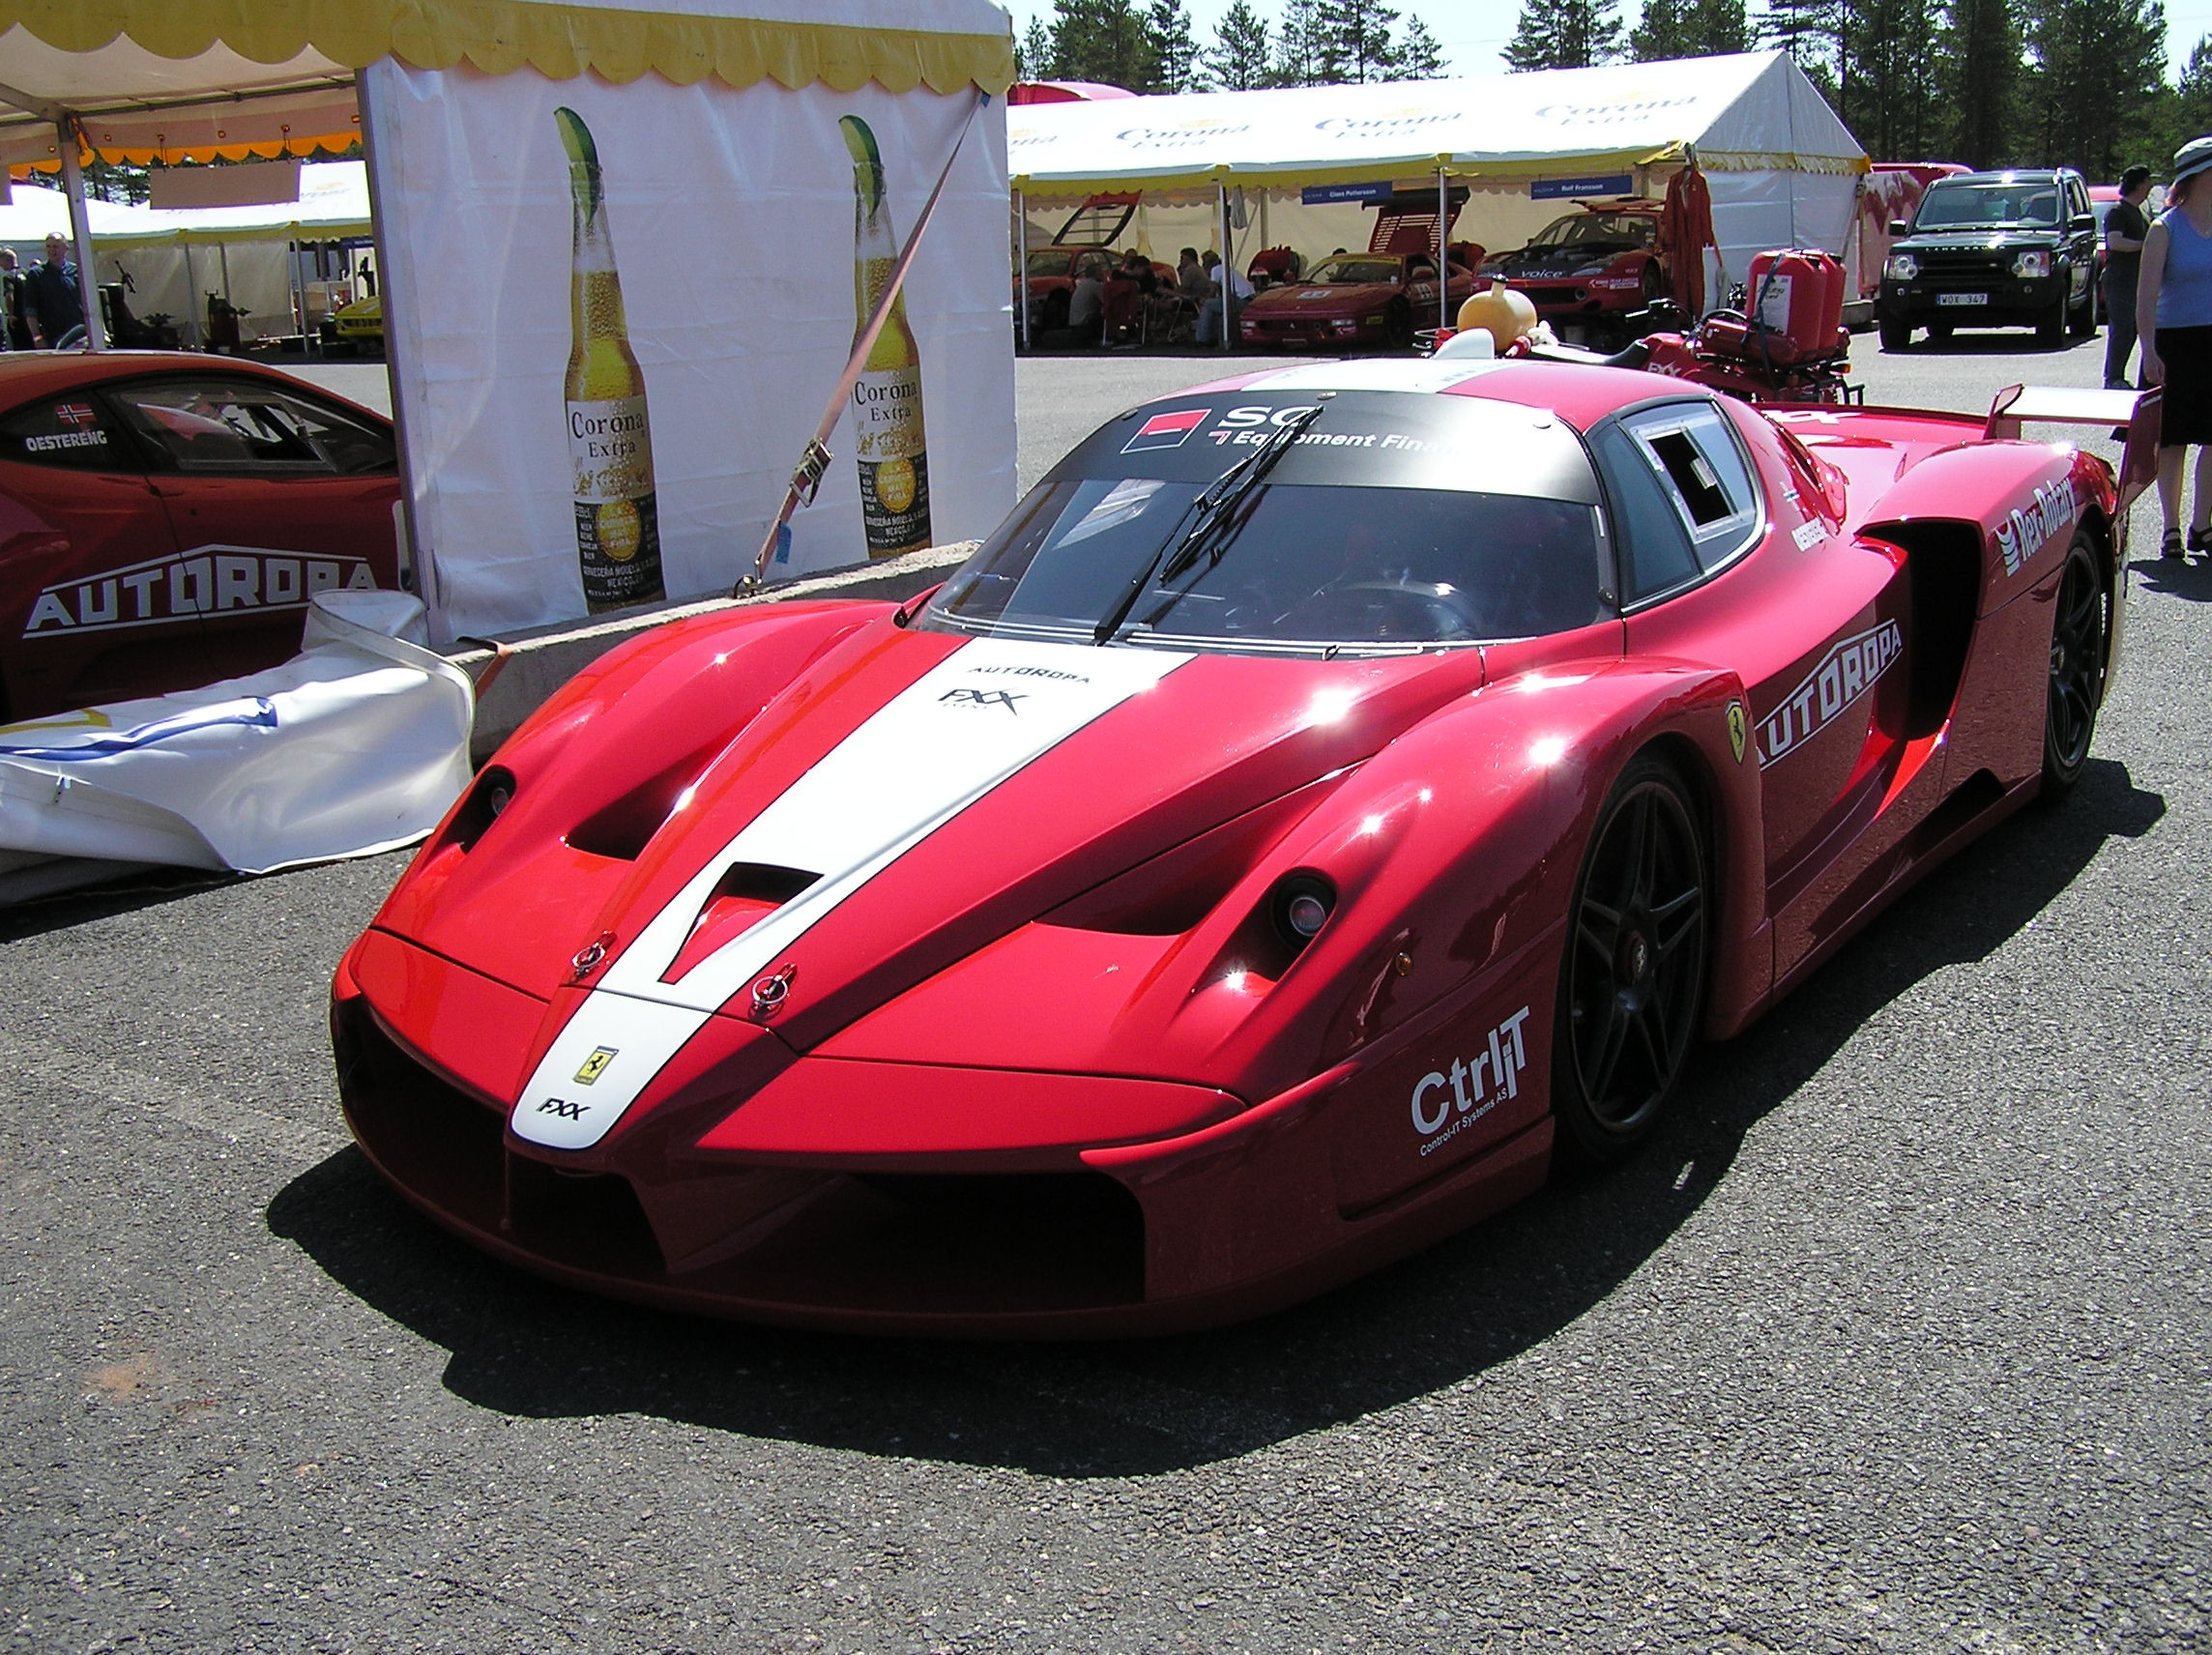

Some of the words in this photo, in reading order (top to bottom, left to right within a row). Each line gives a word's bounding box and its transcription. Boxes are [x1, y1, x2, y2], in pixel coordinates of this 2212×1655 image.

[1534, 96, 1698, 117] Corona
[1116, 125, 1250, 139] Corona
[1315, 112, 1463, 130] Corona
[1521, 270, 1563, 278] voice
[855, 381, 917, 405] Corona
[571, 411, 644, 439] Corona
[870, 407, 911, 421] Extra
[26, 429, 107, 451] OESTERENG
[589, 441, 636, 458] Extra
[25, 555, 379, 630] AUTOROPA
[967, 666, 1091, 684] AUTOROPA
[938, 687, 1031, 716] FXX
[1756, 623, 1902, 765] UTOROPA
[537, 1097, 592, 1121] FXX
[1420, 1121, 1461, 1157] Control-IT
[1462, 1099, 1496, 1127] Systems
[1496, 1088, 1508, 1103] AS
